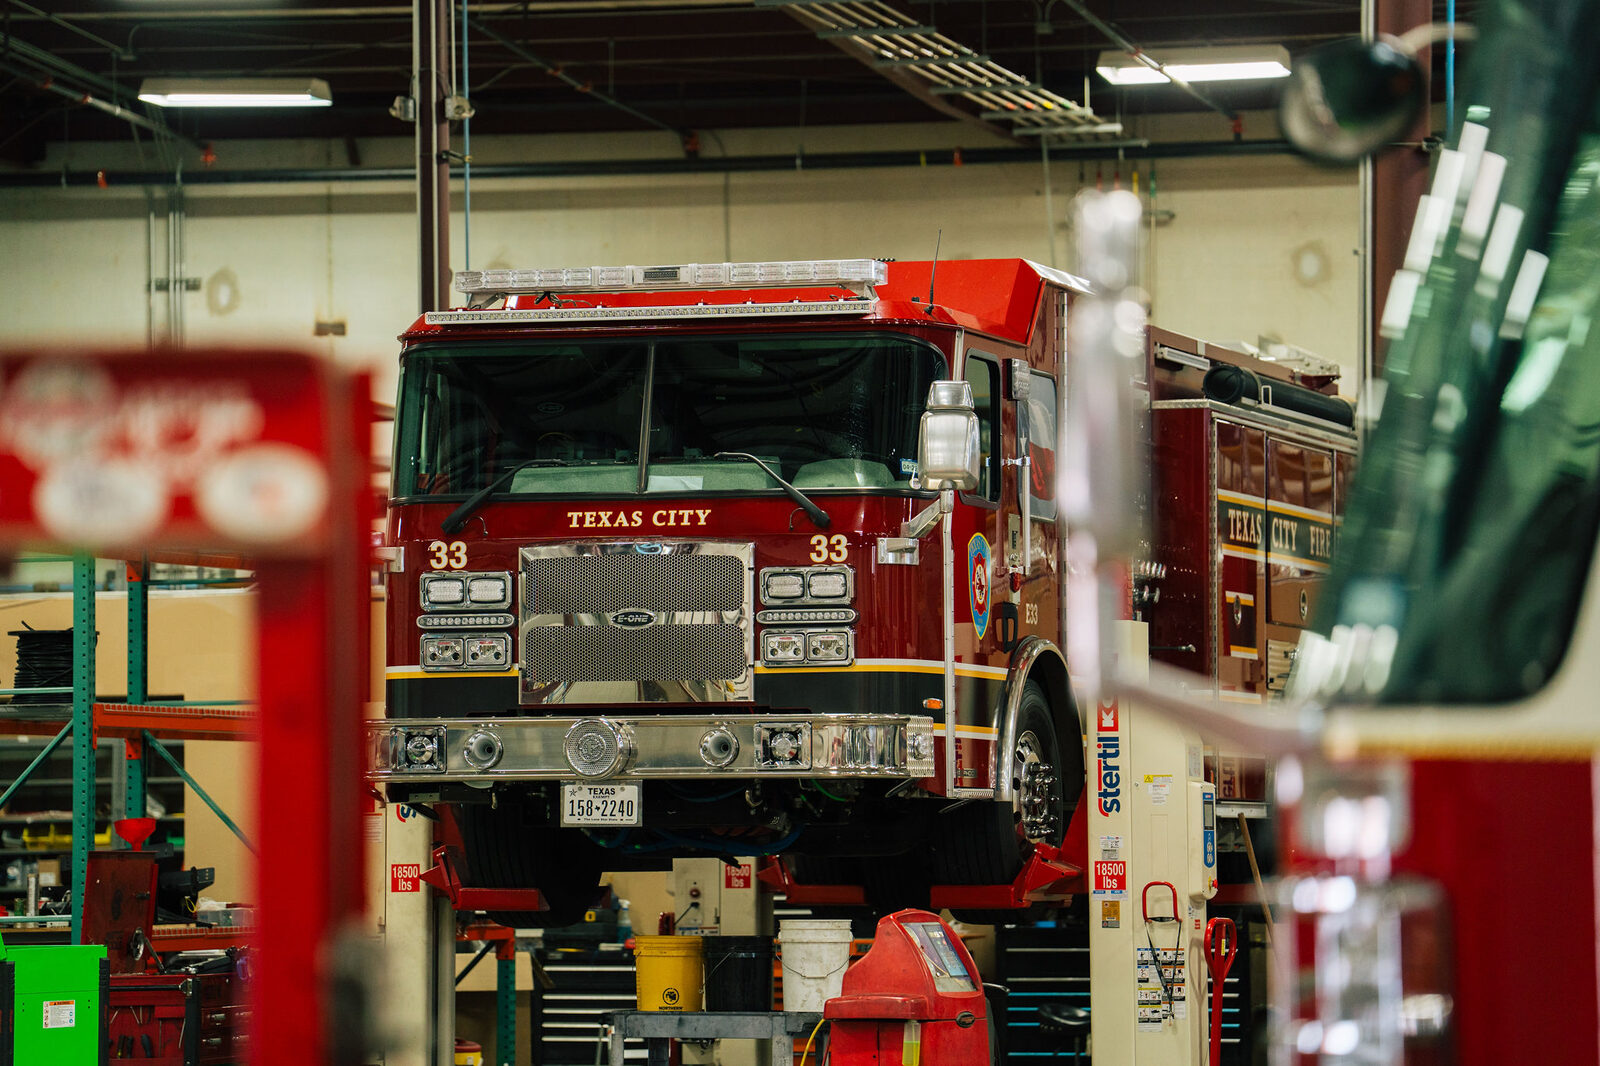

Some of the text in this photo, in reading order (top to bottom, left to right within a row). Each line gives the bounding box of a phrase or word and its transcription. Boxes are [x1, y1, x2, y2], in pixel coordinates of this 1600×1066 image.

[567, 509, 712, 528] TEXAS CITY
[1228, 508, 1331, 558] TEXAS CITY FIRE
[430, 540, 468, 569] 33
[809, 534, 848, 563] 33
[617, 614, 649, 623] E-ONE
[1025, 603, 1038, 625] E33
[1097, 736, 1121, 817] stertil
[392, 865, 418, 878] 18500
[1096, 863, 1124, 876] 18500
[398, 879, 413, 891] lbs
[731, 877, 745, 887] lbs
[1103, 876, 1118, 888] lbs
